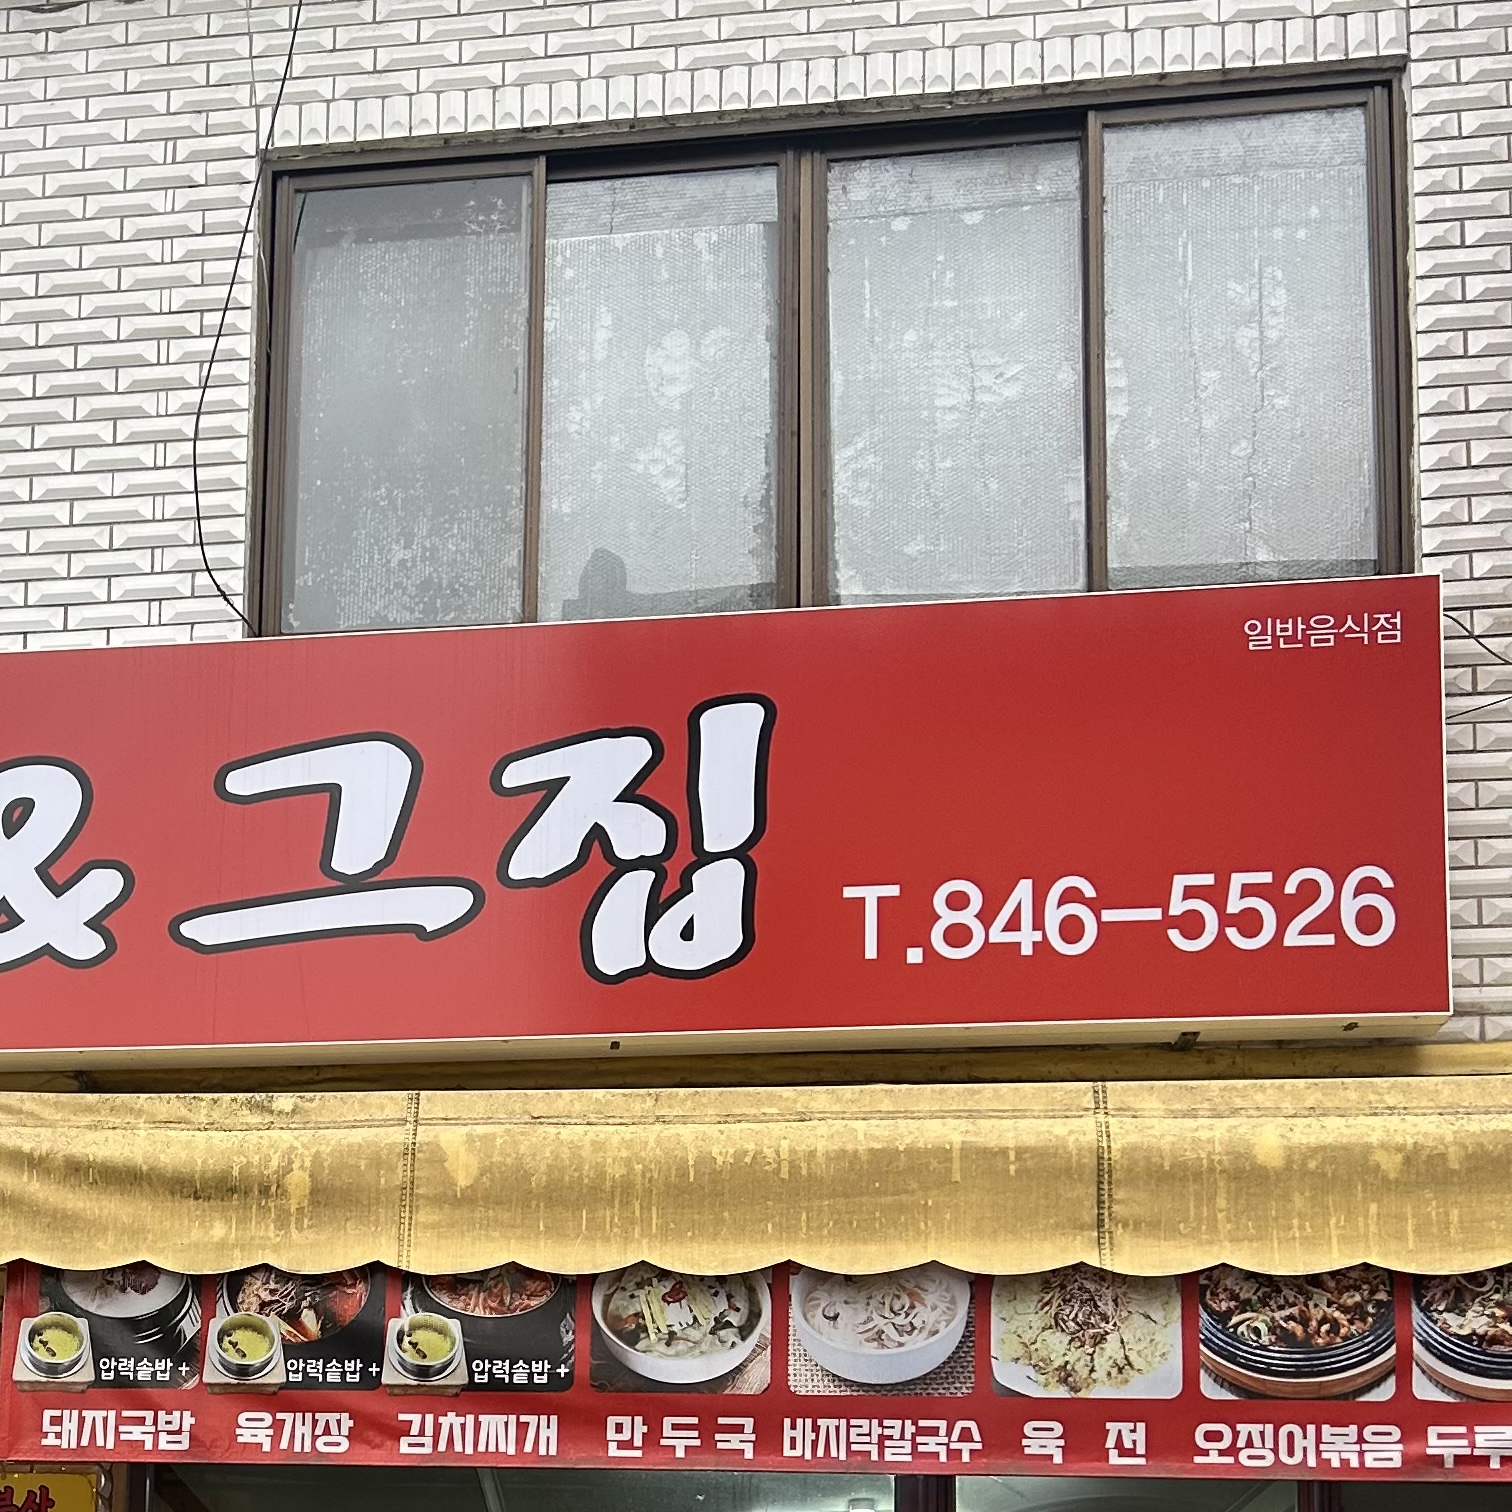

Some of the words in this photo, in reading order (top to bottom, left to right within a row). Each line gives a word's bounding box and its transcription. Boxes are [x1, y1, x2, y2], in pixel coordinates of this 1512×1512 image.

[1243, 612, 1402, 651] 일반음식점
[99, 1357, 173, 1384] 압력솥밥
[286, 1357, 362, 1385] 압력솥밥
[472, 1358, 548, 1385] 압력솥밥
[41, 1409, 194, 1451] 돼지국밥
[235, 1411, 354, 1455] 육개장
[397, 1412, 559, 1457] 김치찌개
[782, 1419, 983, 1464] 바지락칼국수
[1193, 1422, 1404, 1468] 오징어볶음
